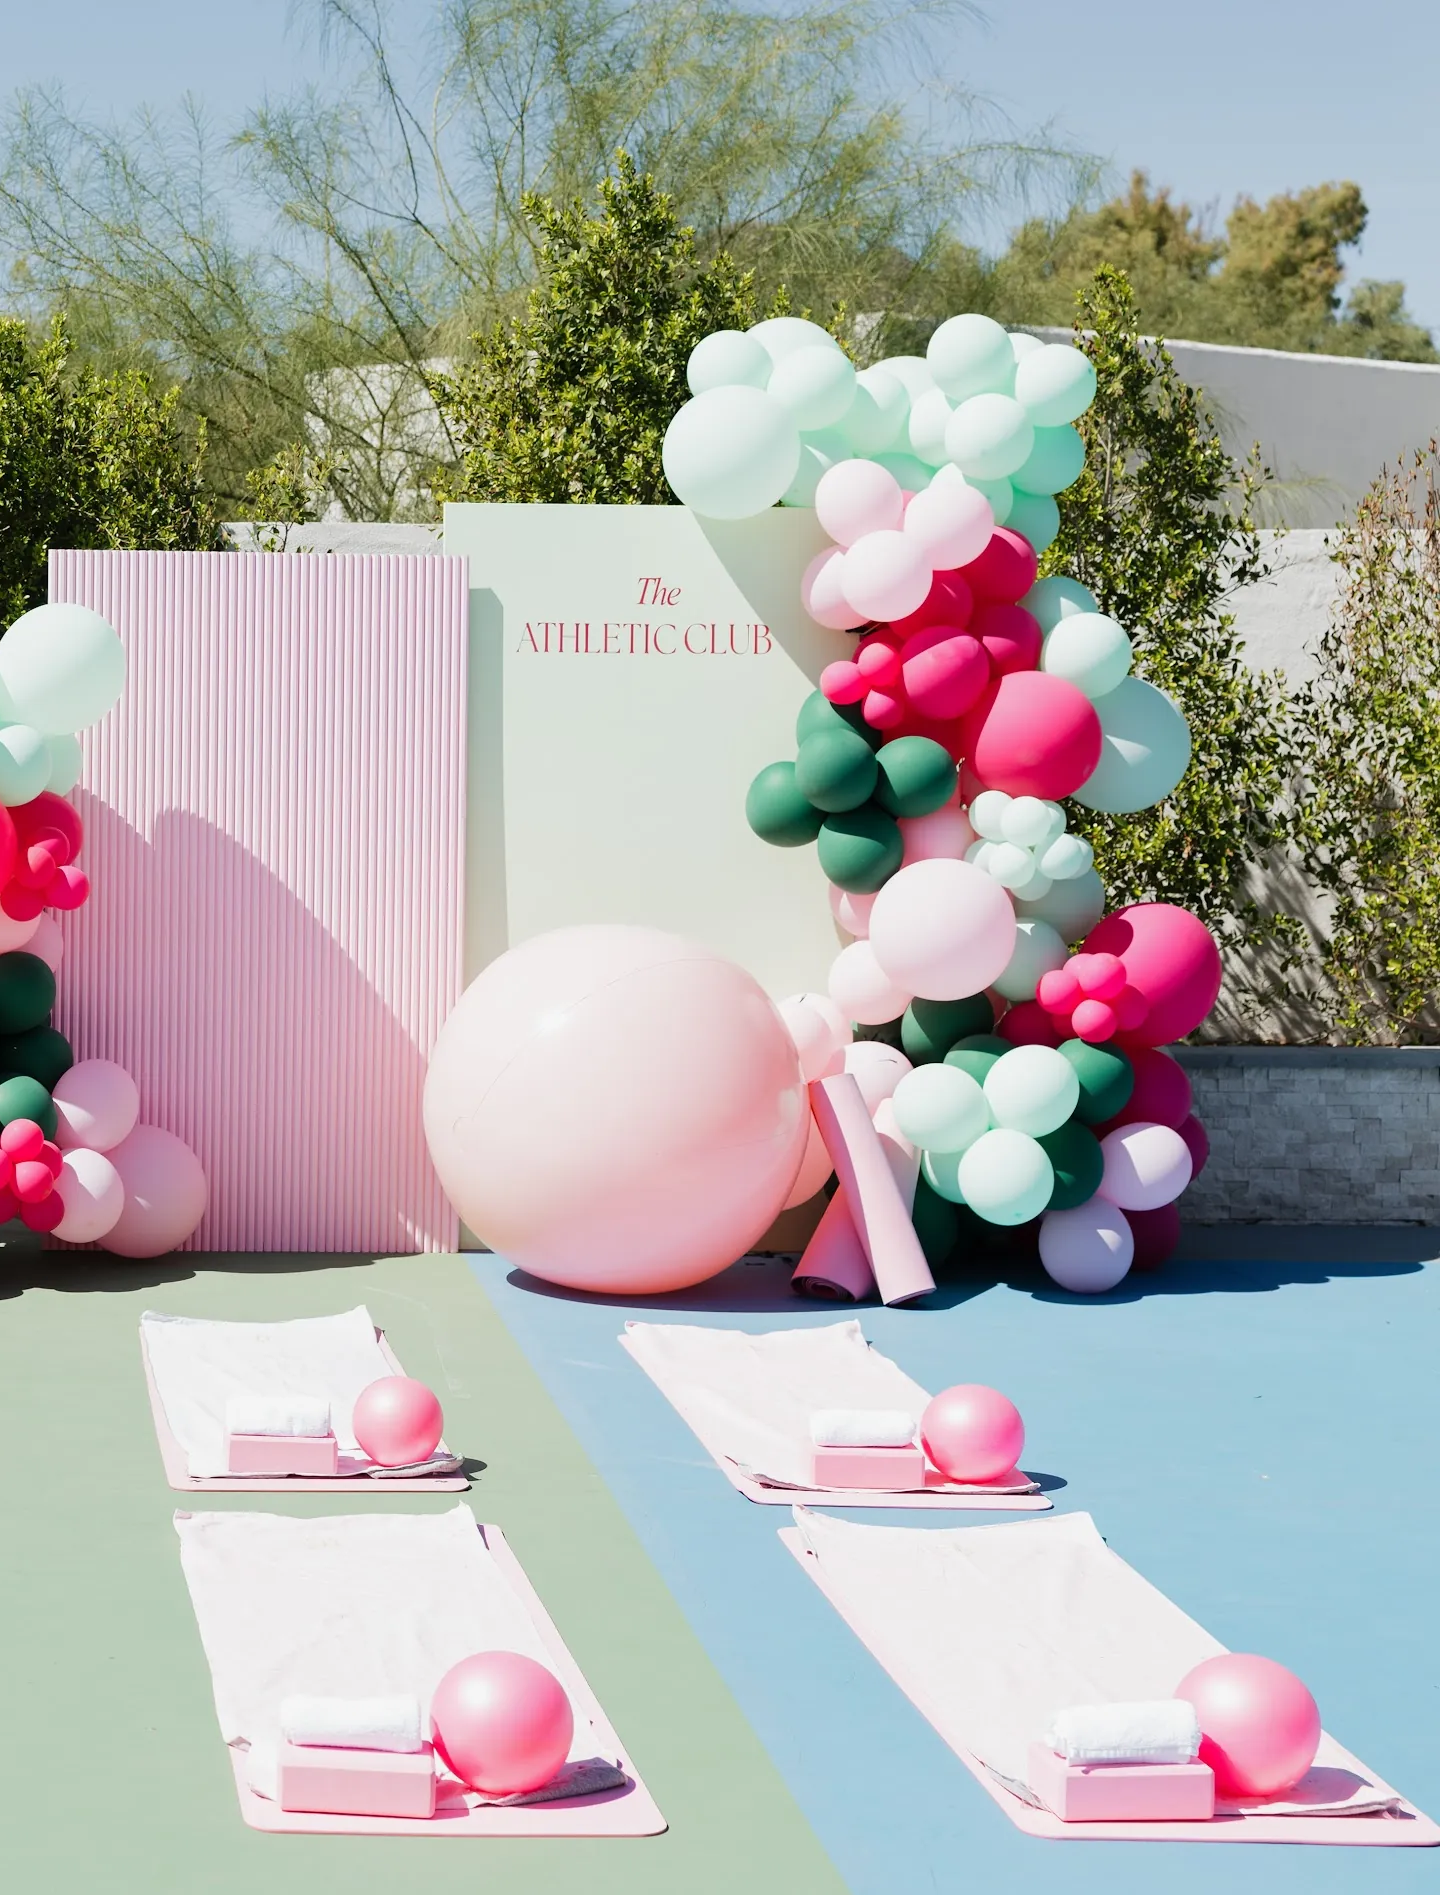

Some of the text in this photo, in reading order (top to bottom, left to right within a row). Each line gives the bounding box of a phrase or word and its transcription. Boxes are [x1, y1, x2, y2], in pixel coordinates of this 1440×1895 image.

[637, 576, 682, 607] The
[516, 621, 773, 656] ATHLETIC CLUB
